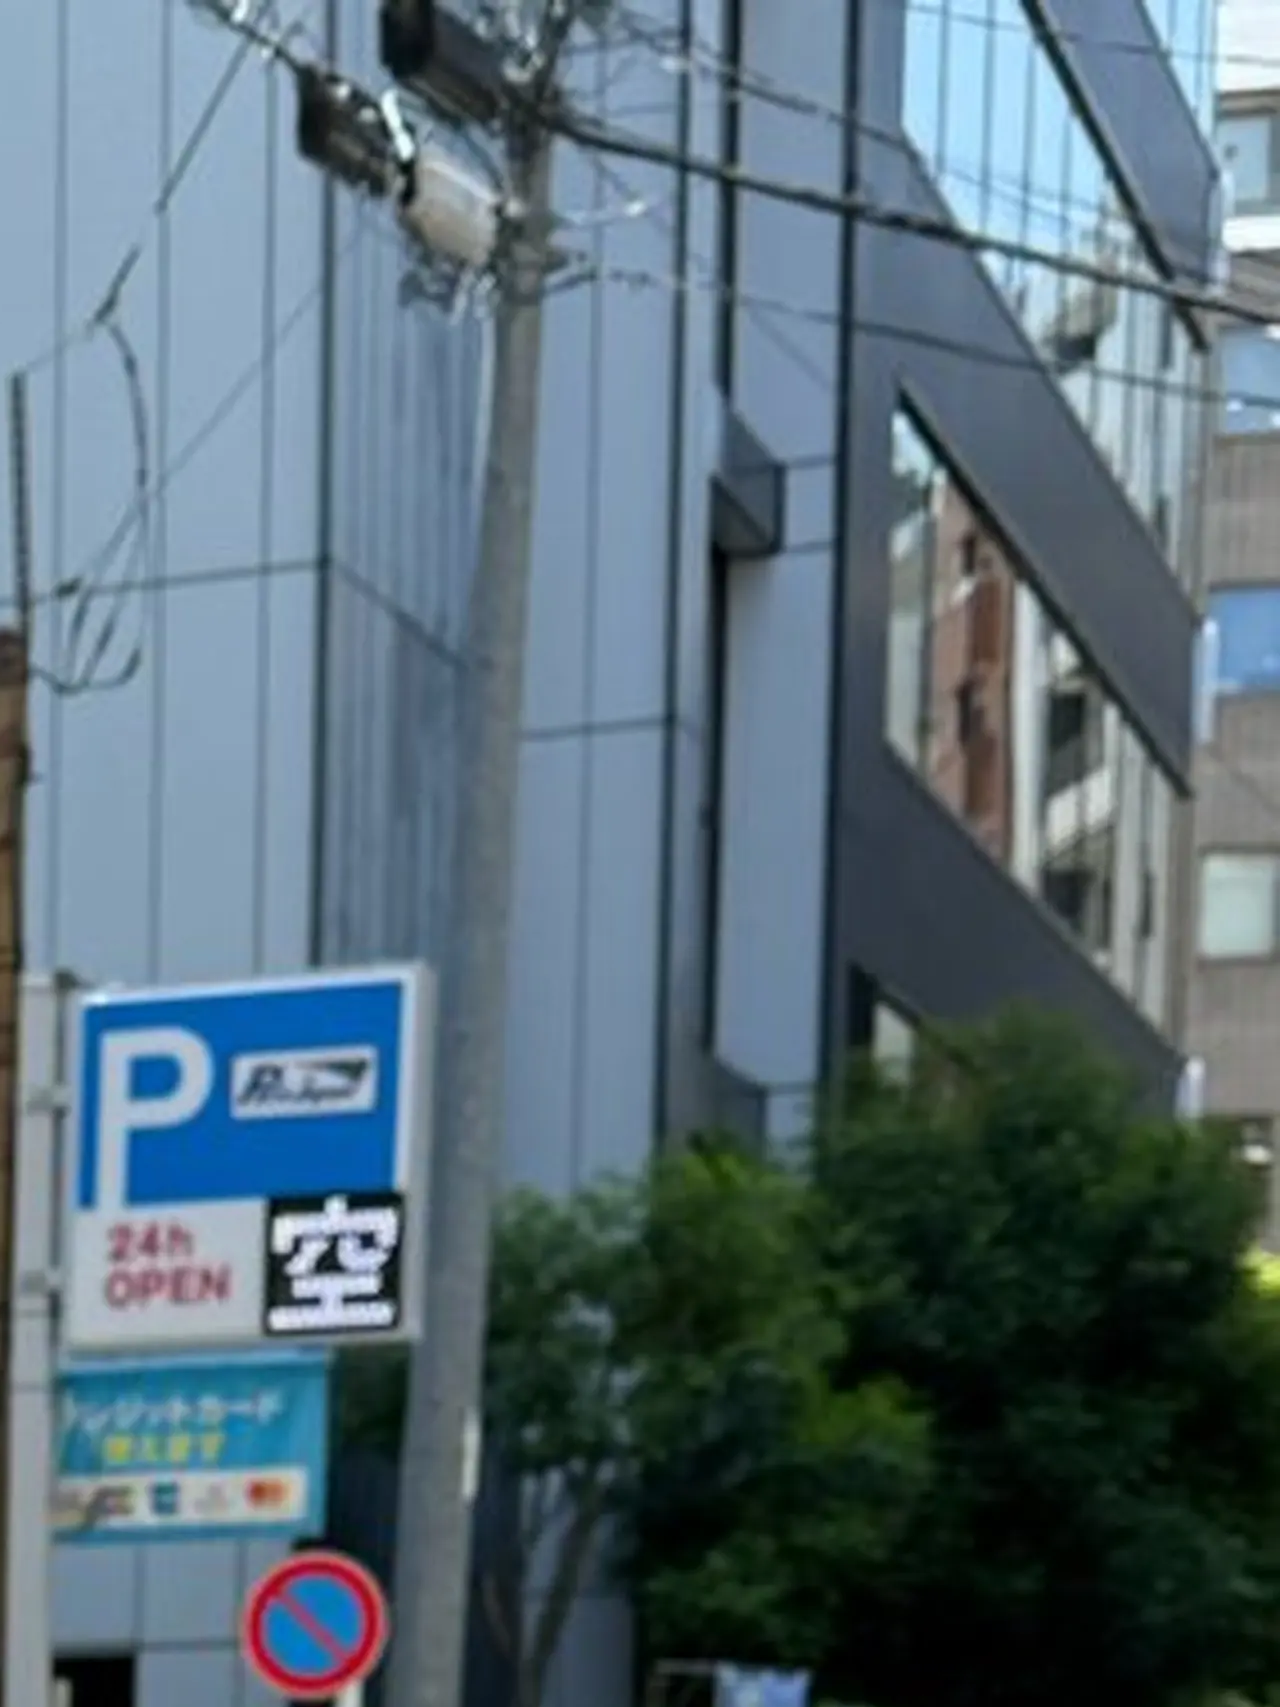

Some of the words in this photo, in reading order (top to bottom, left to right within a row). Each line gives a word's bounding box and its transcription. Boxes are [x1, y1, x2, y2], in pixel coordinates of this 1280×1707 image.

[96, 1026, 214, 1209] P
[105, 1265, 232, 1308] OPEN
[106, 1224, 196, 1264] 24h
[268, 1195, 399, 1331] 空
